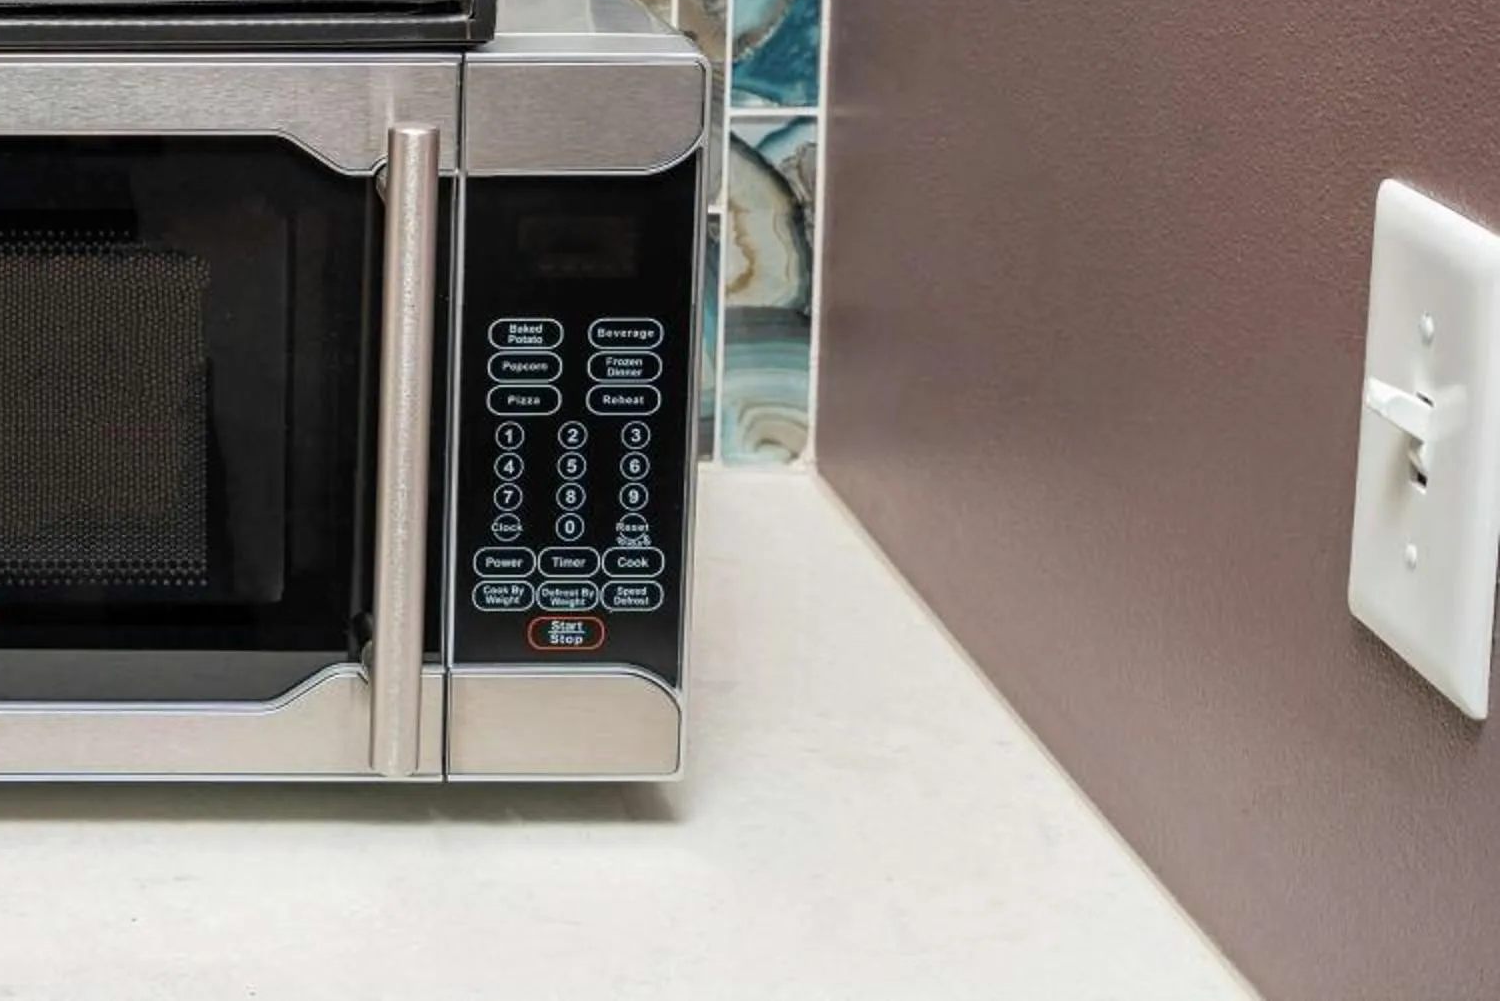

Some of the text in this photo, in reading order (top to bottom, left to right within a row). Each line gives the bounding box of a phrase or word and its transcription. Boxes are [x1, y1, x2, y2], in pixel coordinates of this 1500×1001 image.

[508, 324, 543, 334] Baked
[597, 328, 655, 339] Beverage
[507, 335, 543, 344] Potato
[502, 361, 549, 372] Popcorn
[606, 357, 643, 366] Frozen
[606, 367, 643, 377] Dinner
[507, 395, 541, 405] Pizza
[603, 395, 645, 405] Reheat
[504, 429, 514, 442] 1
[567, 429, 580, 442] 2
[631, 429, 642, 442] 3
[503, 460, 515, 474] 4
[566, 460, 578, 473] 5
[629, 460, 641, 473] 6
[503, 490, 514, 503] 7
[565, 490, 577, 504] 8
[628, 490, 640, 503] 9
[491, 523, 523, 532] Clock
[564, 521, 576, 534] 0
[615, 522, 649, 532] Reset
[485, 557, 524, 567] Power
[552, 557, 586, 568] Timer
[617, 556, 650, 568] Cook
[483, 586, 525, 596] Cook By
[581, 589, 595, 599] By
[617, 587, 648, 597] Speed
[485, 595, 521, 606] Weight
[613, 596, 649, 605] Defrost
[550, 621, 583, 631] Start
[550, 634, 584, 645] Stop
